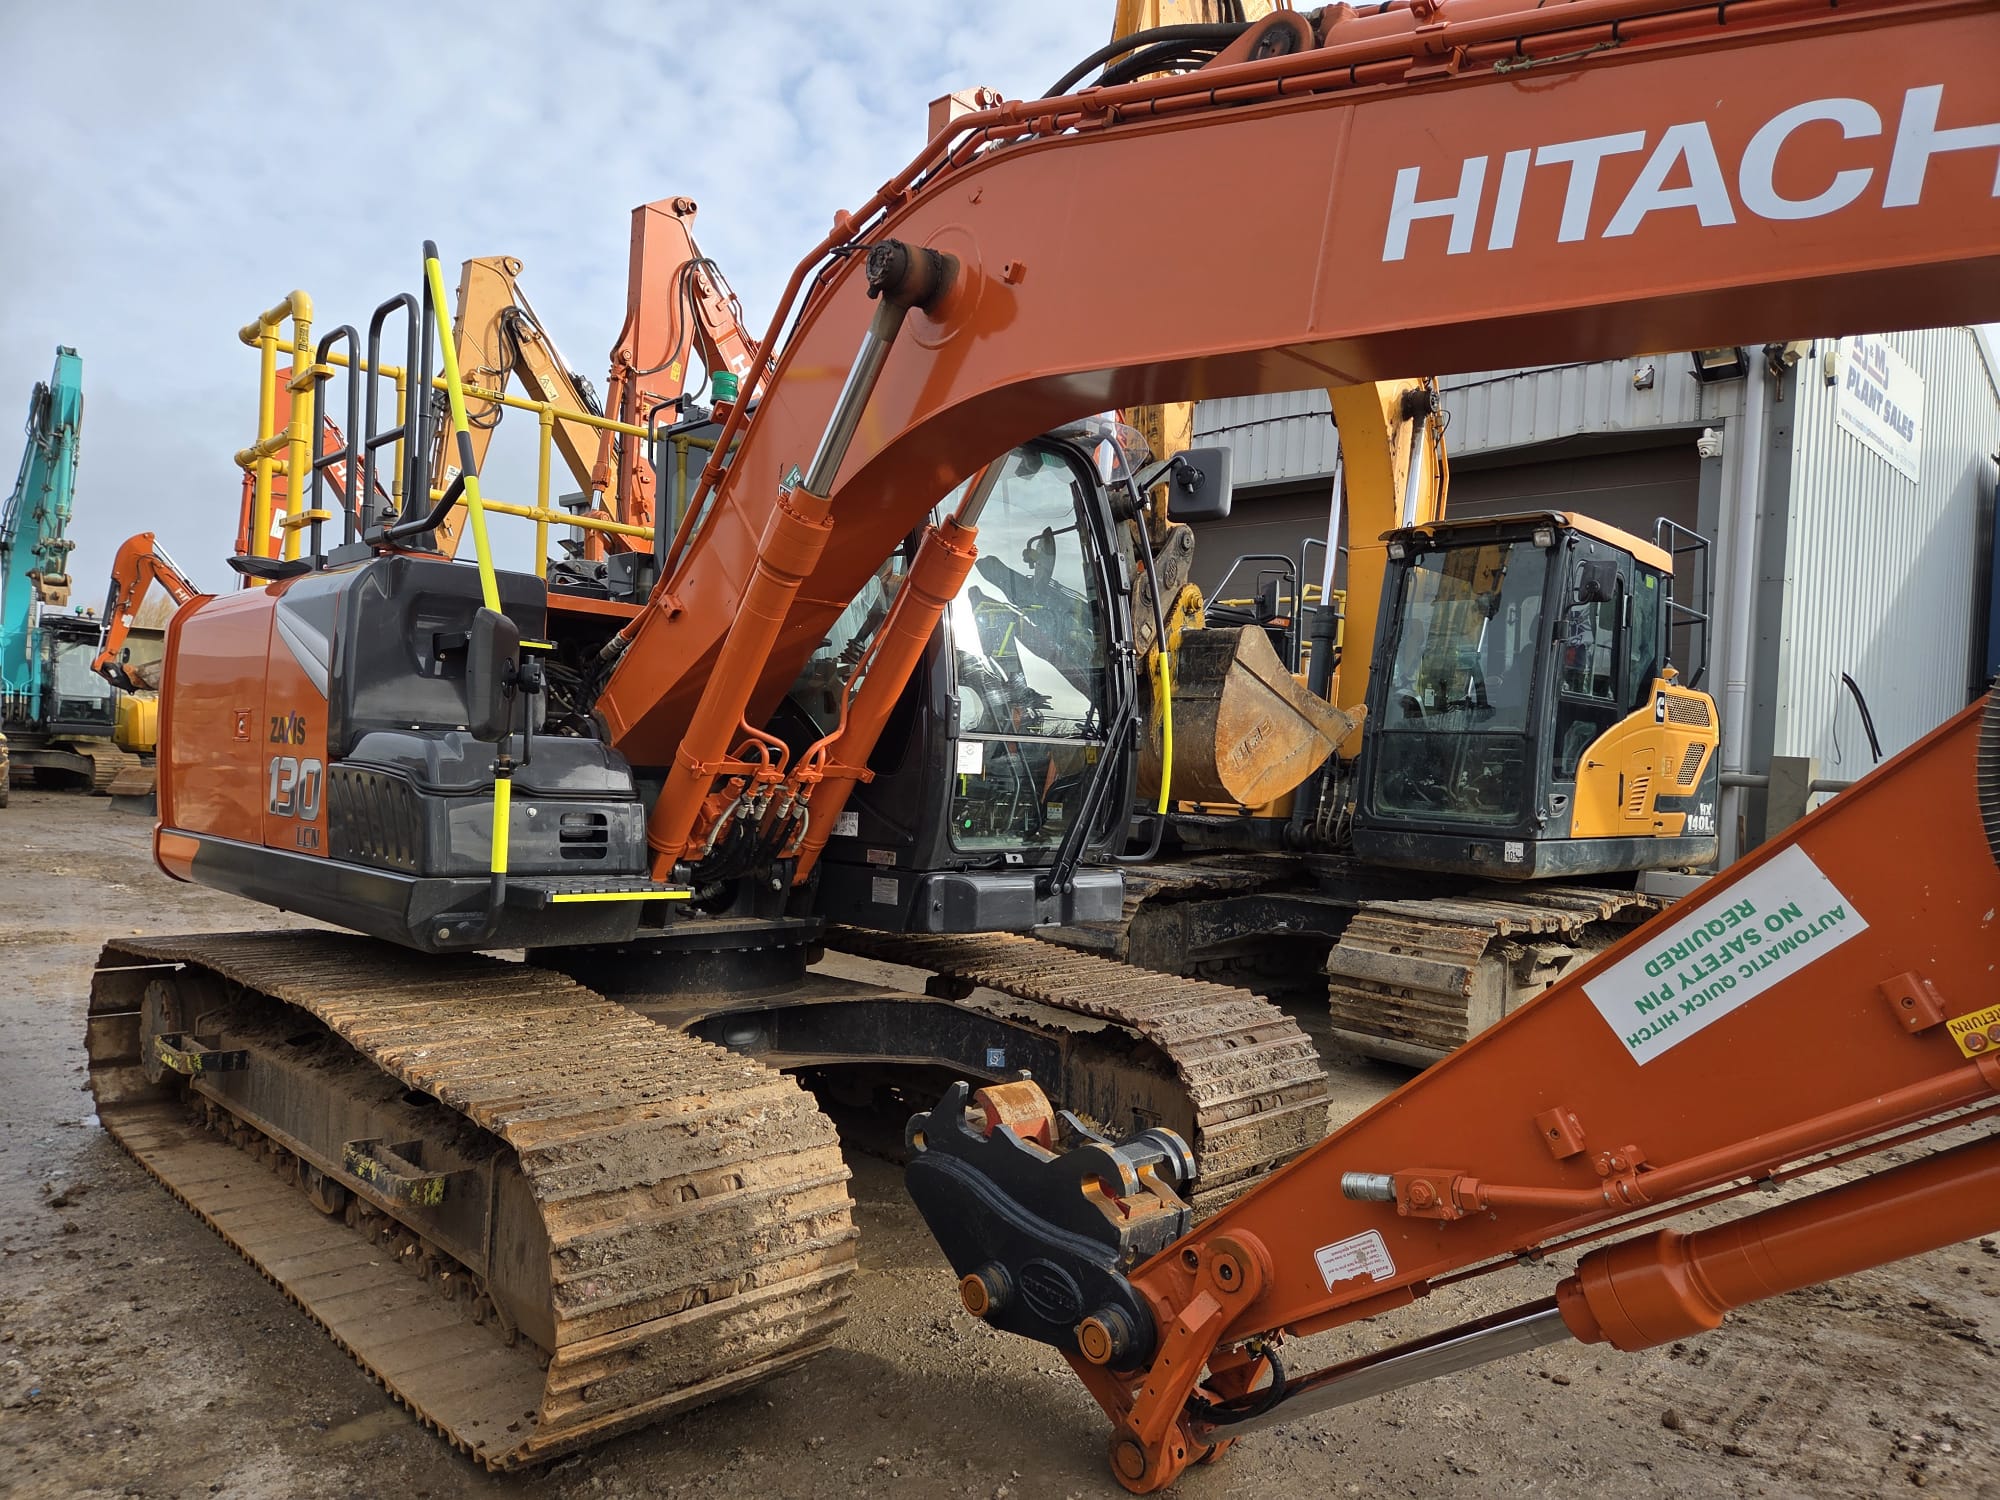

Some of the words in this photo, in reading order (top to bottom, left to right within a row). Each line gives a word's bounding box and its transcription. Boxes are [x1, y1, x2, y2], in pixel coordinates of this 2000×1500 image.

[1846, 364, 1884, 417] PLANT
[1883, 399, 1914, 444] SALES
[270, 710, 306, 745] ZAXIS
[269, 756, 322, 820] 130
[1700, 803, 1712, 816] HX
[1644, 898, 1757, 977] REQUIRED
[1763, 901, 1803, 932] NO
[1677, 928, 1762, 990] SAFETY
[1738, 904, 1847, 978] AUTOMATIC
[1634, 982, 1675, 1015] PIN
[1678, 974, 1737, 1016] QUICK
[1626, 1010, 1680, 1049] HITCH
